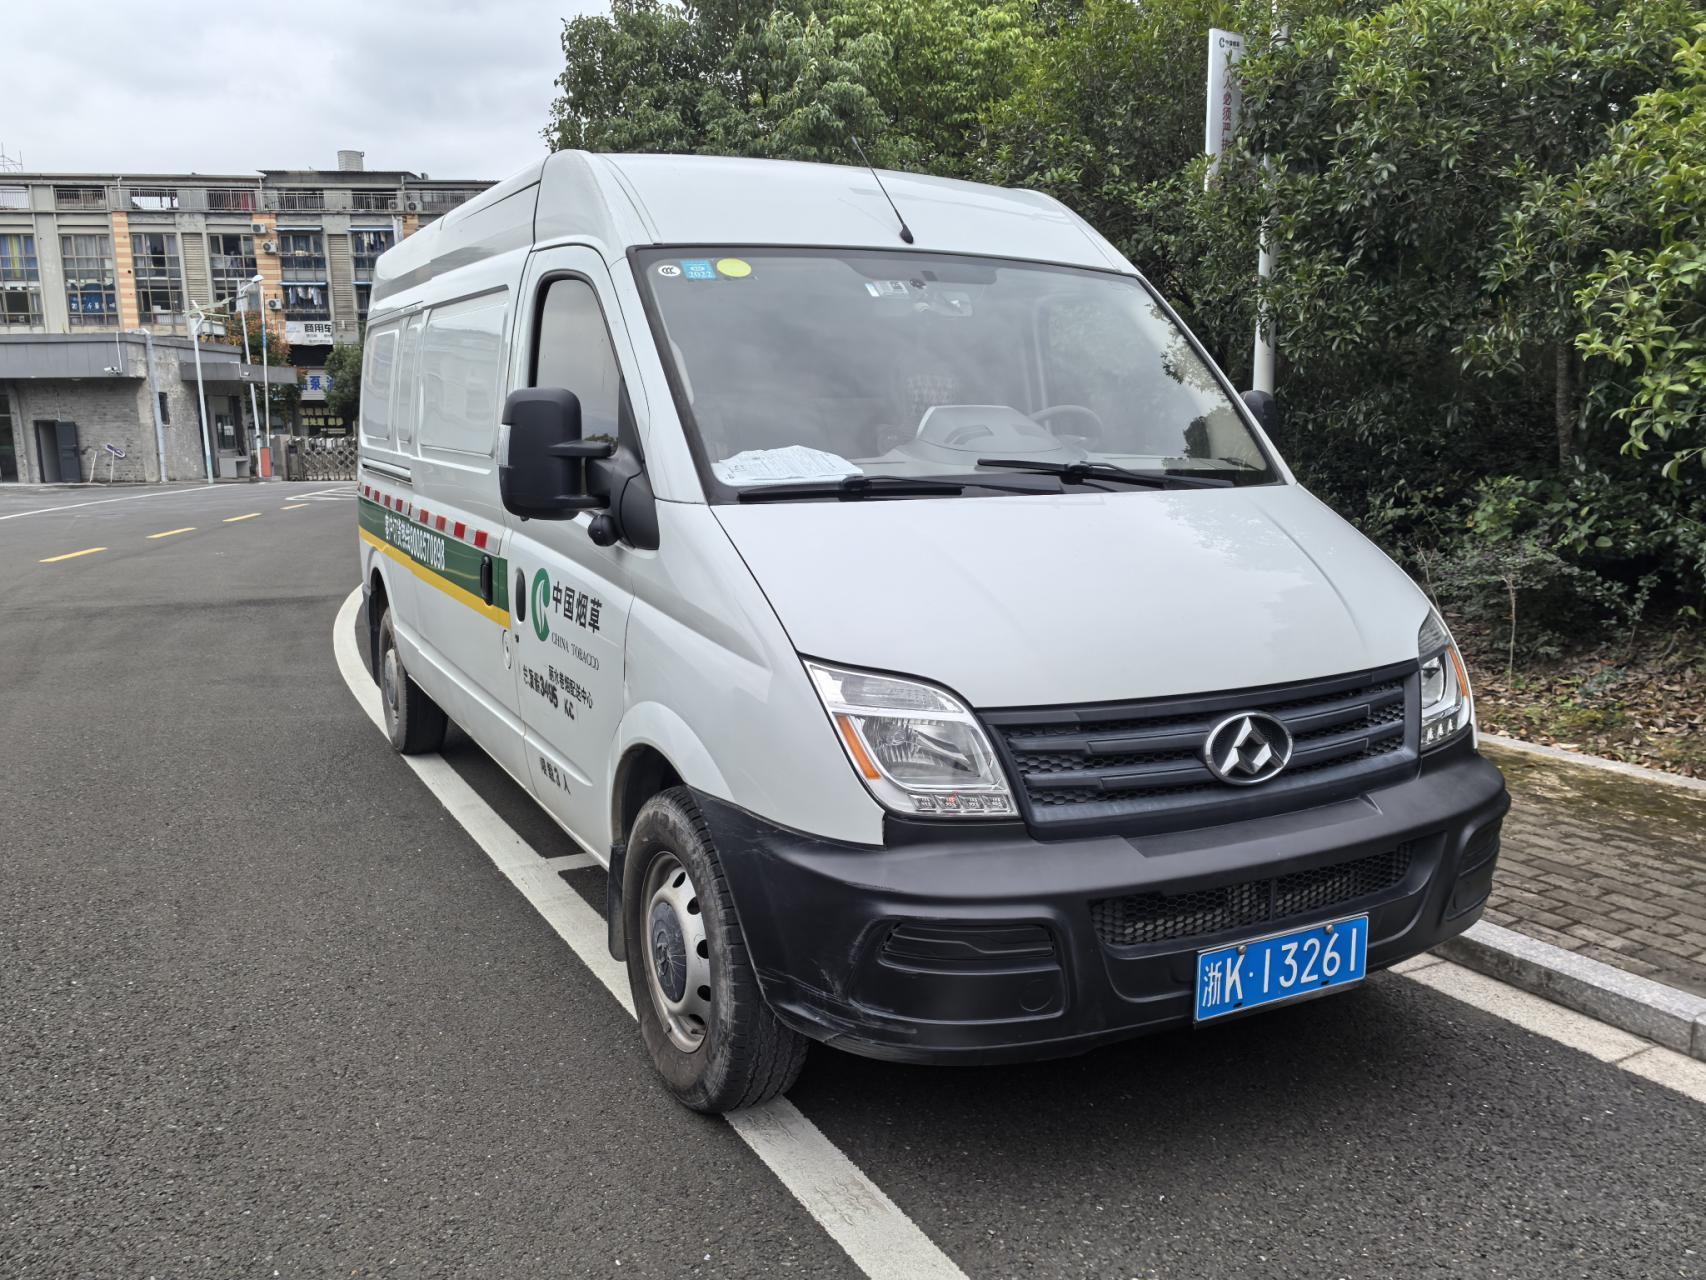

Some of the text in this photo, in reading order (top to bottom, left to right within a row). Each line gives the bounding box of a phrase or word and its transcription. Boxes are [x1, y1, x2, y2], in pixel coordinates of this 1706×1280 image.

[552, 580, 602, 634] 中国烟草
[551, 632, 600, 671] CHINA TOBACCO
[548, 665, 593, 709] 丽水卷烟配送中心
